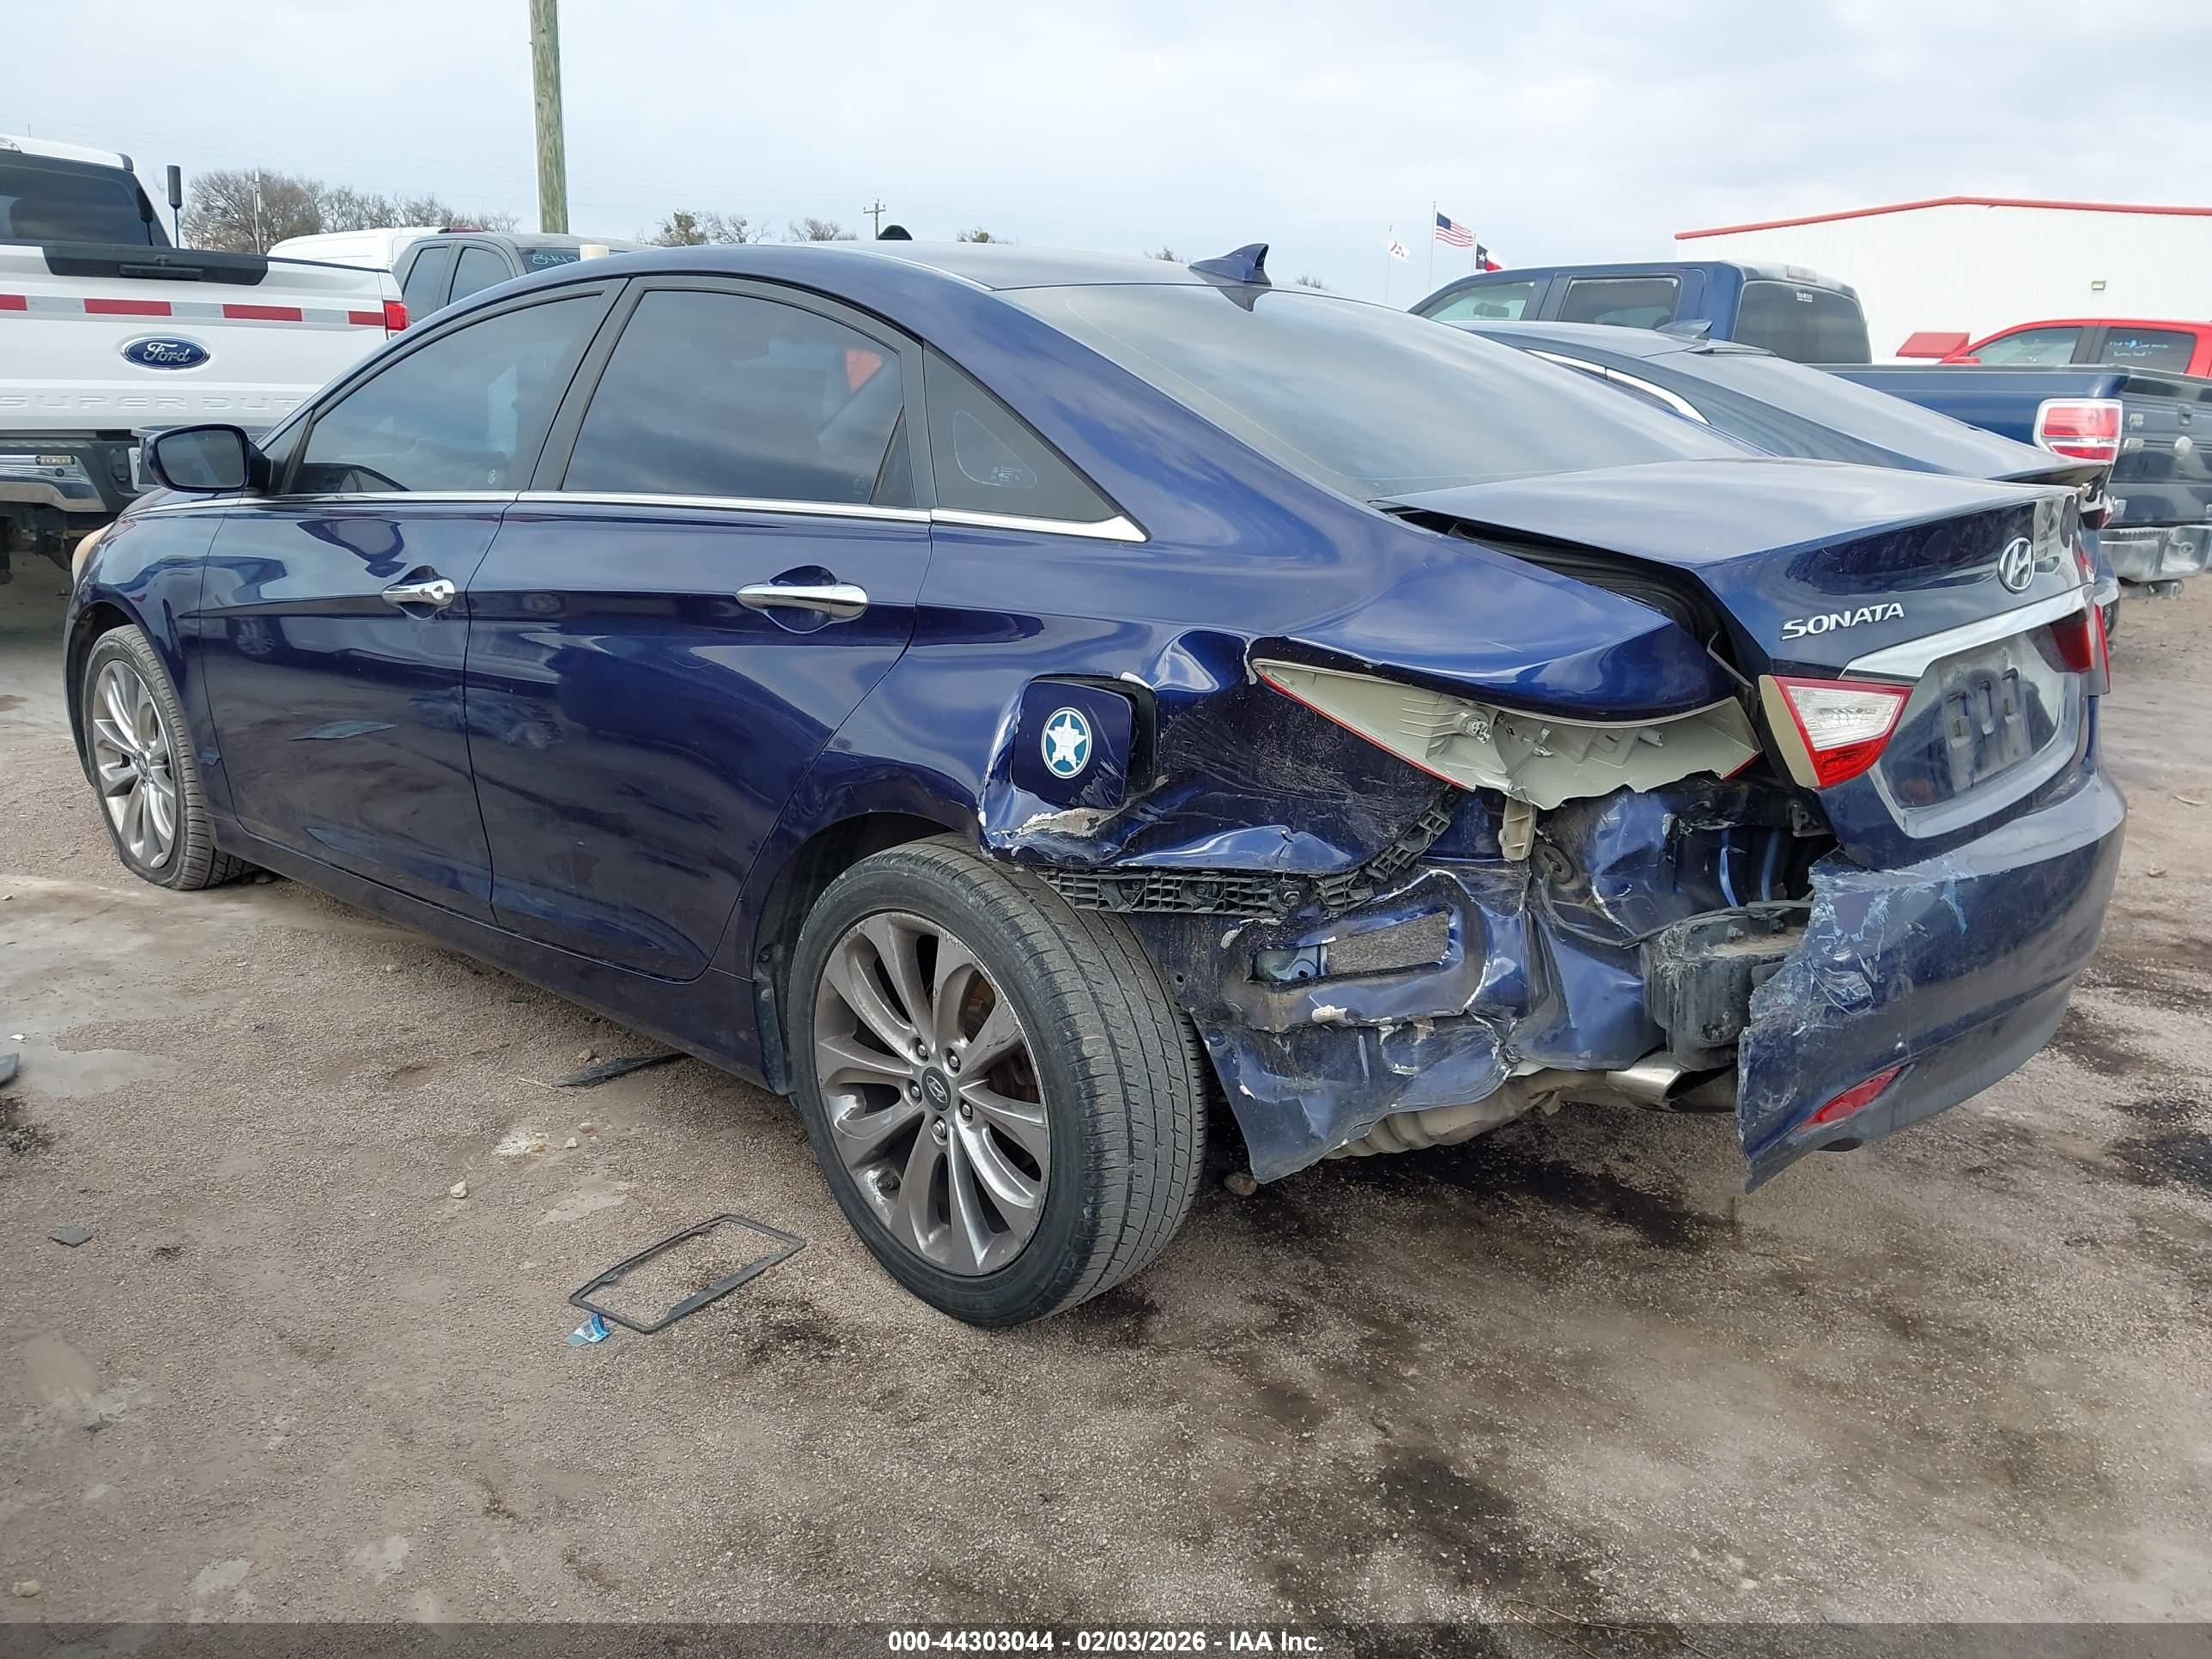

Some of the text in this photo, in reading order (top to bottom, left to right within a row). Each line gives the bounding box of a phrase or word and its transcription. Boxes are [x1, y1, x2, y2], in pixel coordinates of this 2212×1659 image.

[143, 342, 191, 362] Ford
[0, 395, 301, 410] SUPER DUT
[1781, 602, 1905, 641] SONATA
